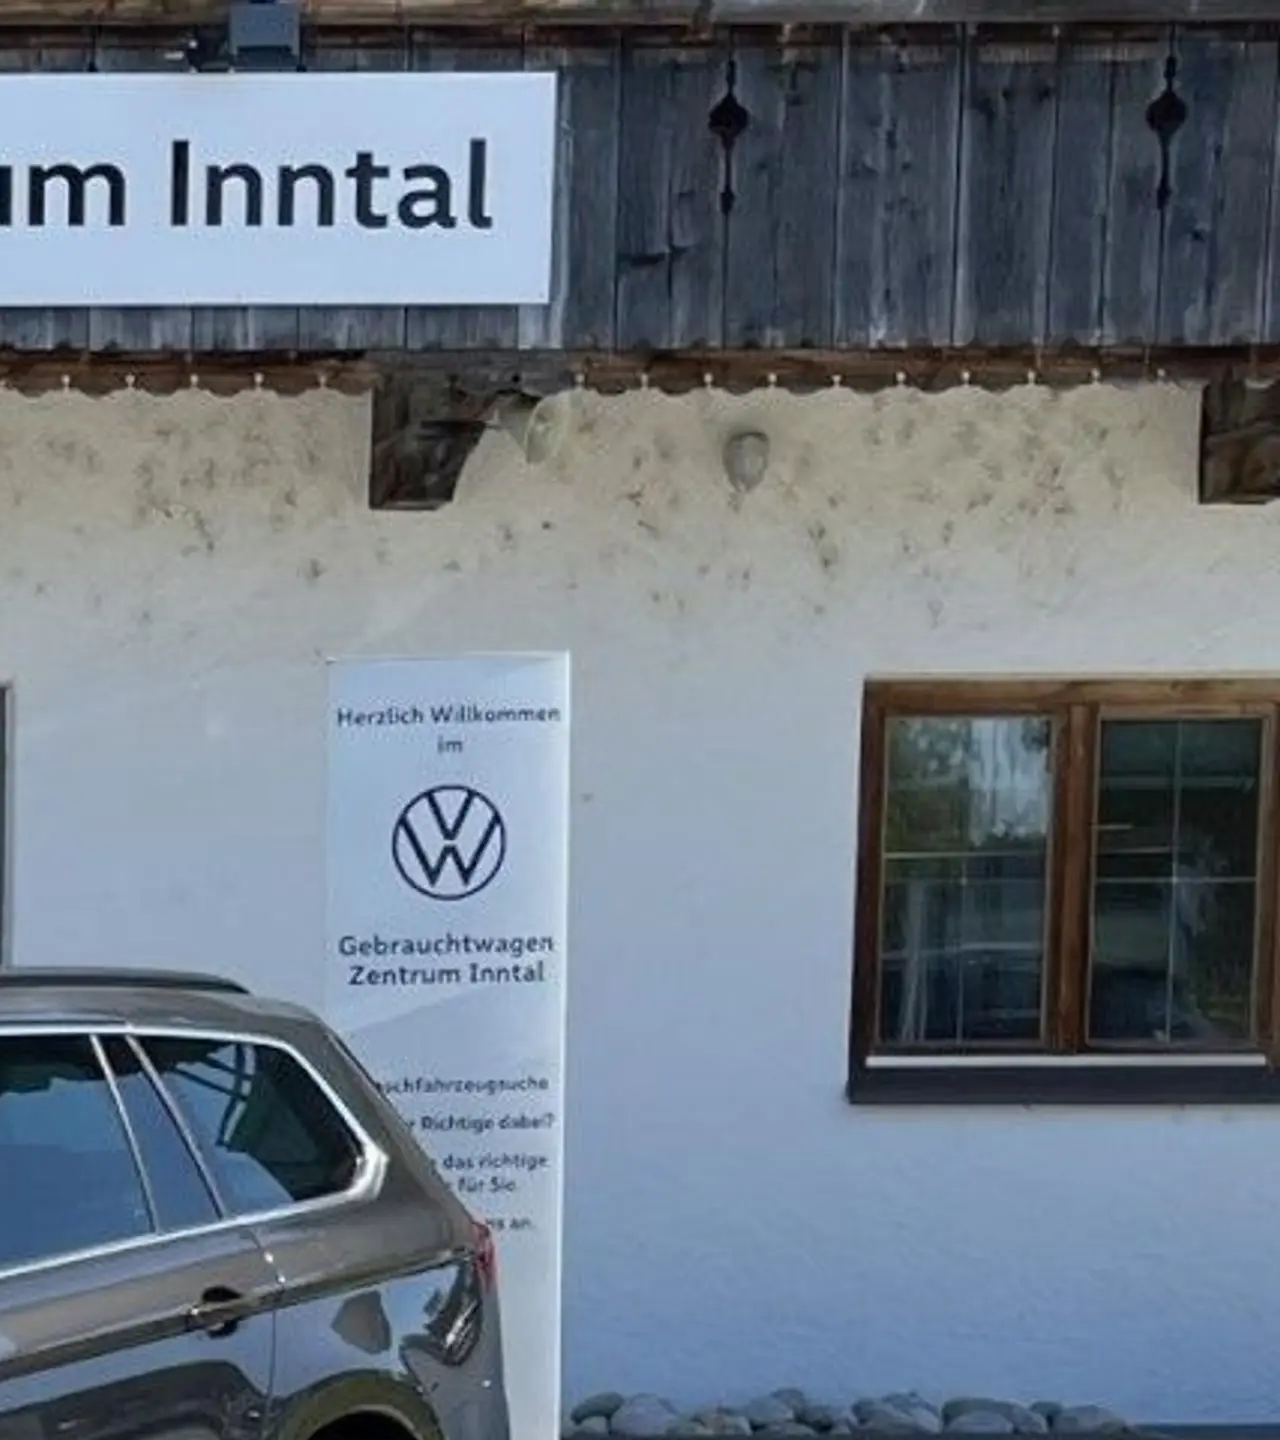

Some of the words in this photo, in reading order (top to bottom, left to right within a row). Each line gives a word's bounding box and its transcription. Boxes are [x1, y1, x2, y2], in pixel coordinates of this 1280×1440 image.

[170, 137, 493, 230] Inntal
[337, 707, 424, 727] Herzlich
[430, 704, 559, 724] Willkommen
[437, 735, 463, 753] im
[338, 932, 553, 958] Gebrauchtwagen
[349, 965, 461, 986] Zentrum
[469, 960, 544, 984] Inntal
